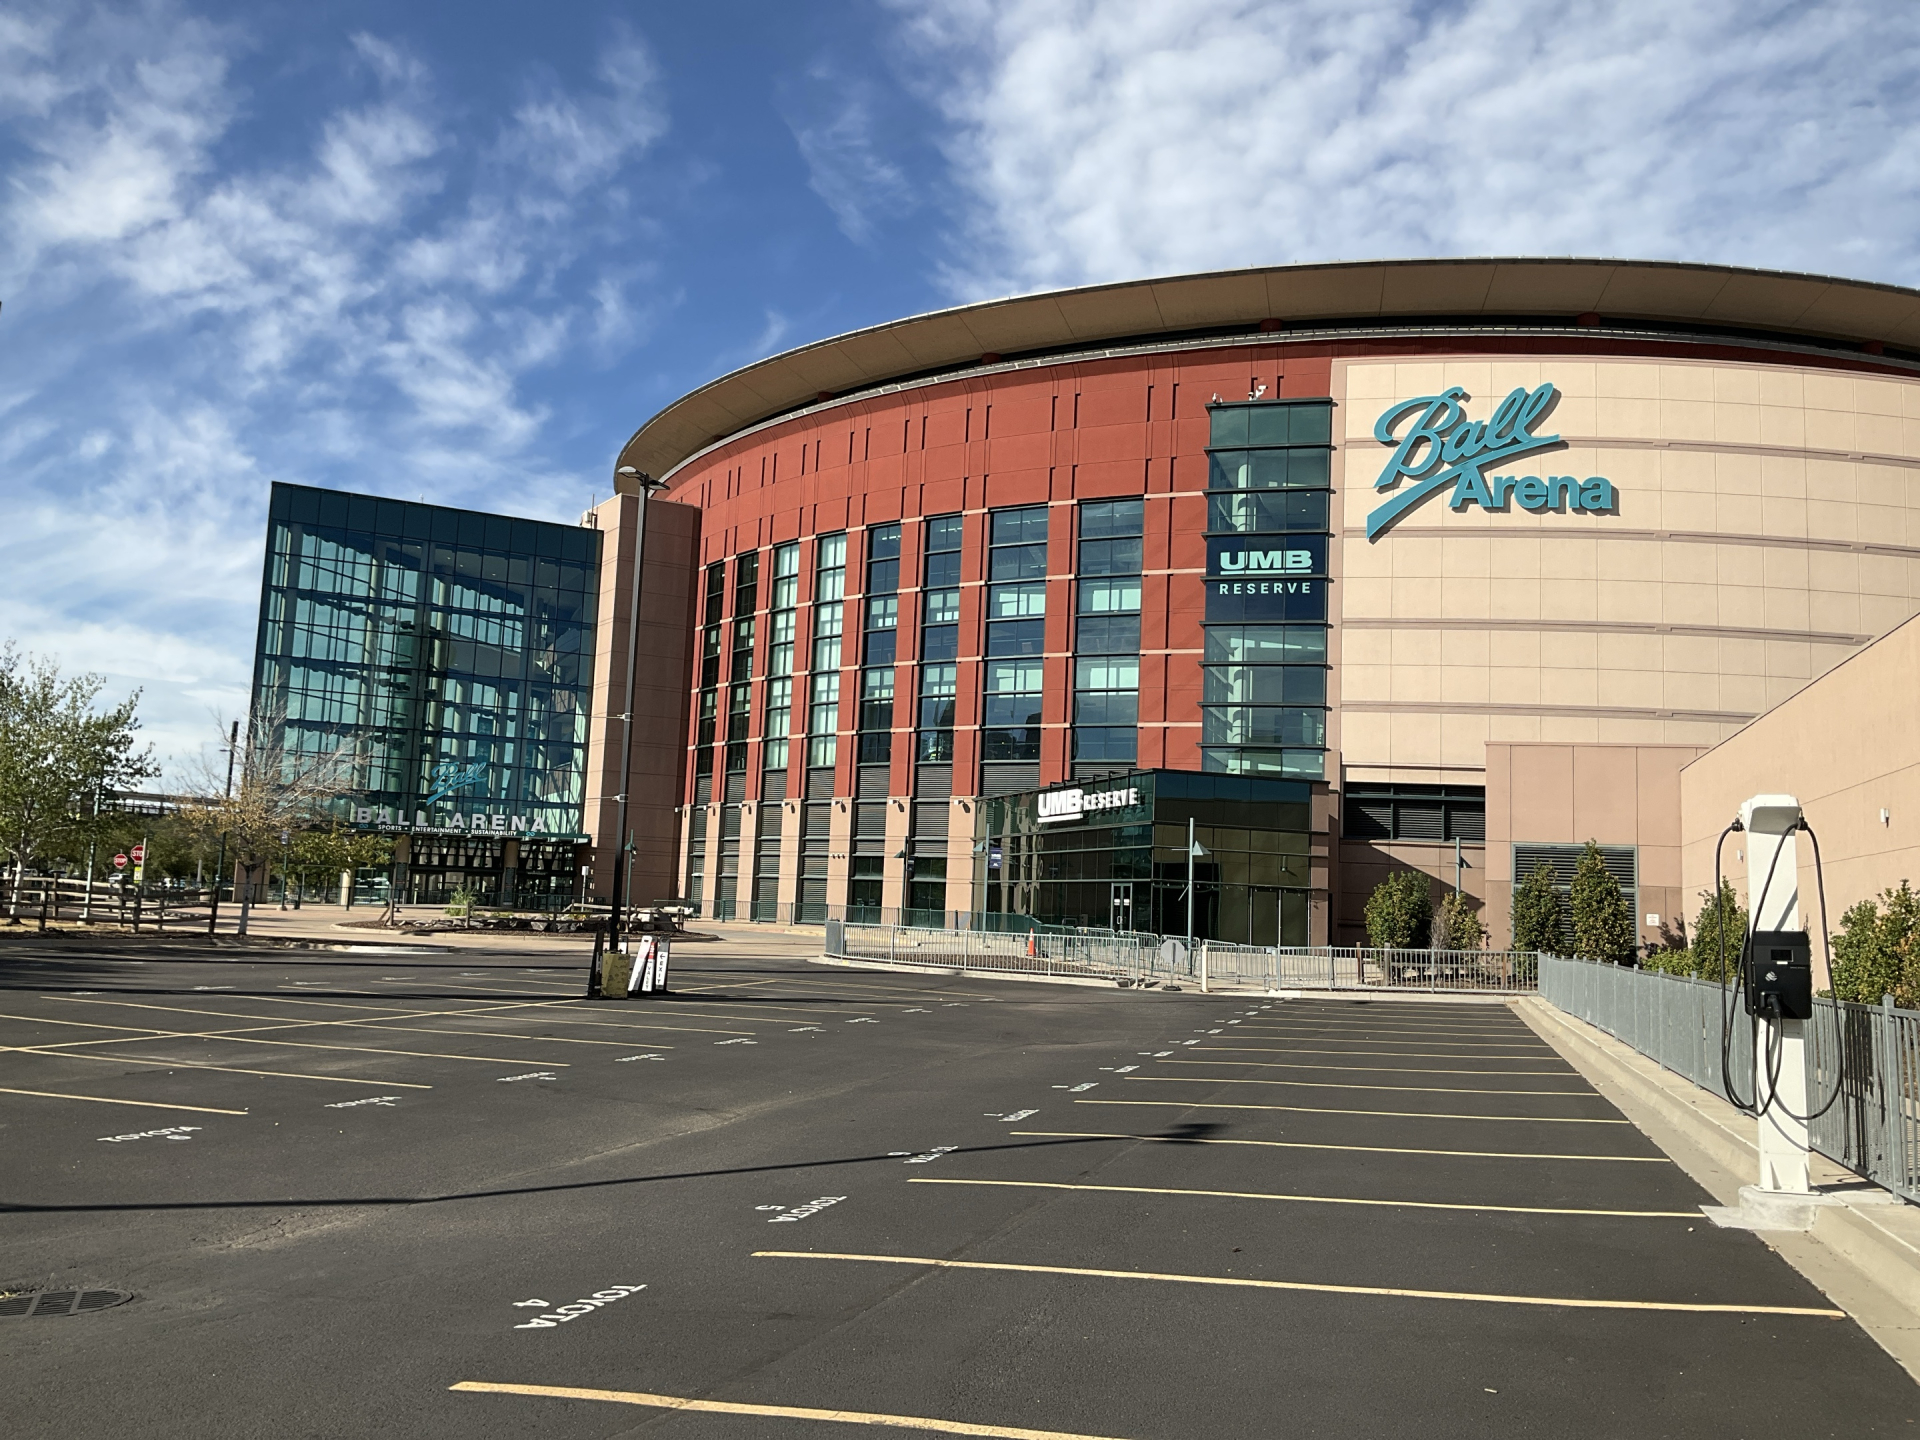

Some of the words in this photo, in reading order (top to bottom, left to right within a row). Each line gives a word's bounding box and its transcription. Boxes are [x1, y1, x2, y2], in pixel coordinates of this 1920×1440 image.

[1367, 383, 1560, 539] Ball
[1449, 464, 1613, 509] Arena
[1220, 550, 1313, 570] UMB
[1219, 583, 1311, 595] RESERVE
[426, 761, 487, 806] Ball
[1037, 788, 1084, 818] UMB
[1083, 788, 1139, 811] RESERVE
[356, 808, 428, 827] BALL
[449, 812, 546, 833] ARENA
[411, 825, 462, 834] ENTERTAINMENT
[470, 829, 517, 837] SUSTAINABILITY
[96, 1126, 203, 1143] TOYOTA
[767, 1195, 848, 1223] TOYOTA
[512, 1298, 551, 1308] 4
[514, 1283, 648, 1329] TOYOTA
